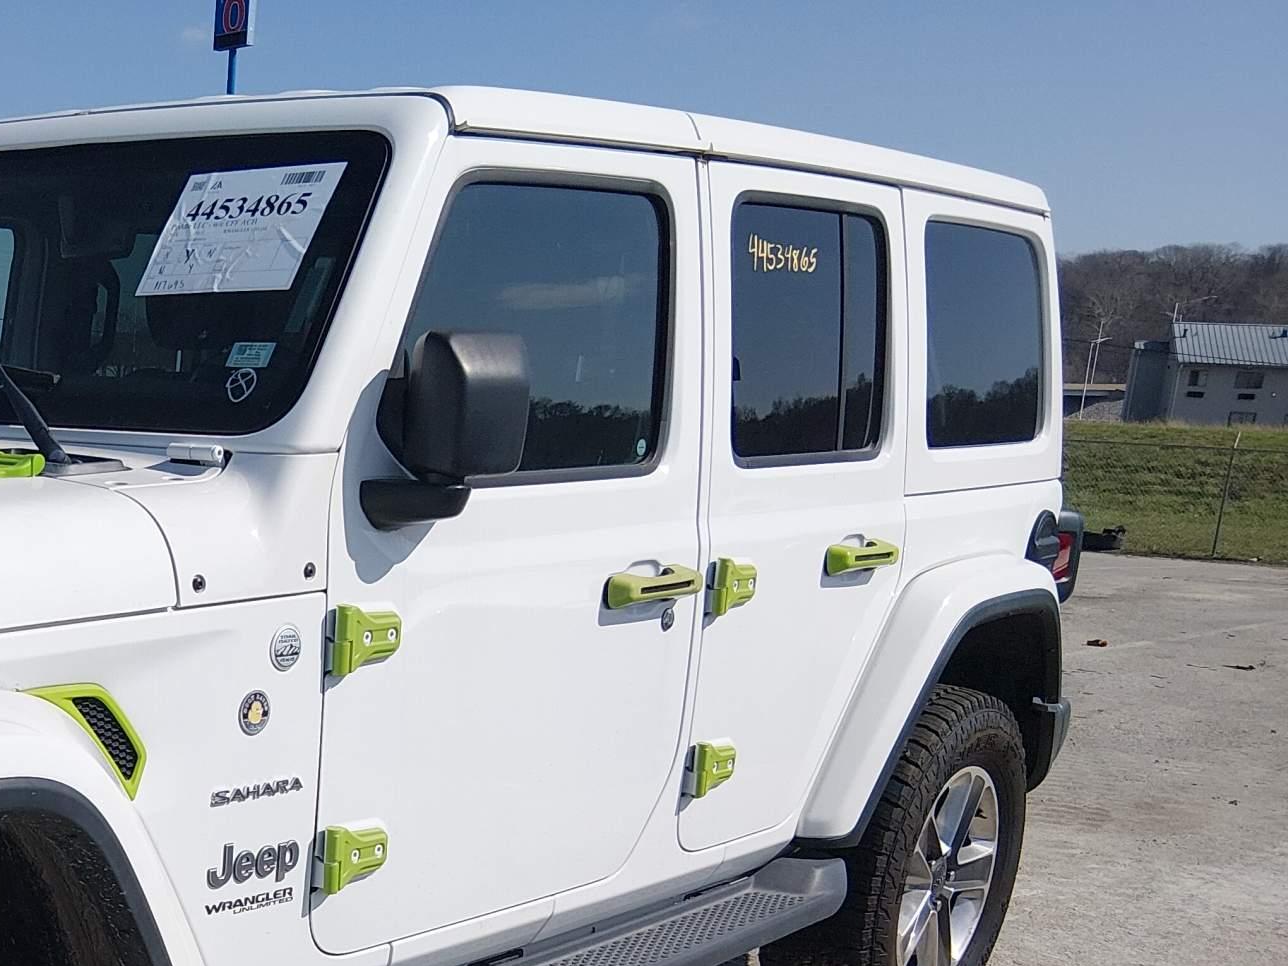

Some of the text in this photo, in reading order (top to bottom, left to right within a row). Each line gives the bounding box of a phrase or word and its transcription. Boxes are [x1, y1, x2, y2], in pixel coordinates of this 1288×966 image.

[186, 192, 312, 221] 44534865
[748, 231, 818, 273] 44534865
[210, 777, 303, 807] SAHARA
[206, 839, 300, 890] Jeep
[205, 887, 293, 915] WRANGLER
[233, 897, 293, 914] UNLIMITED
